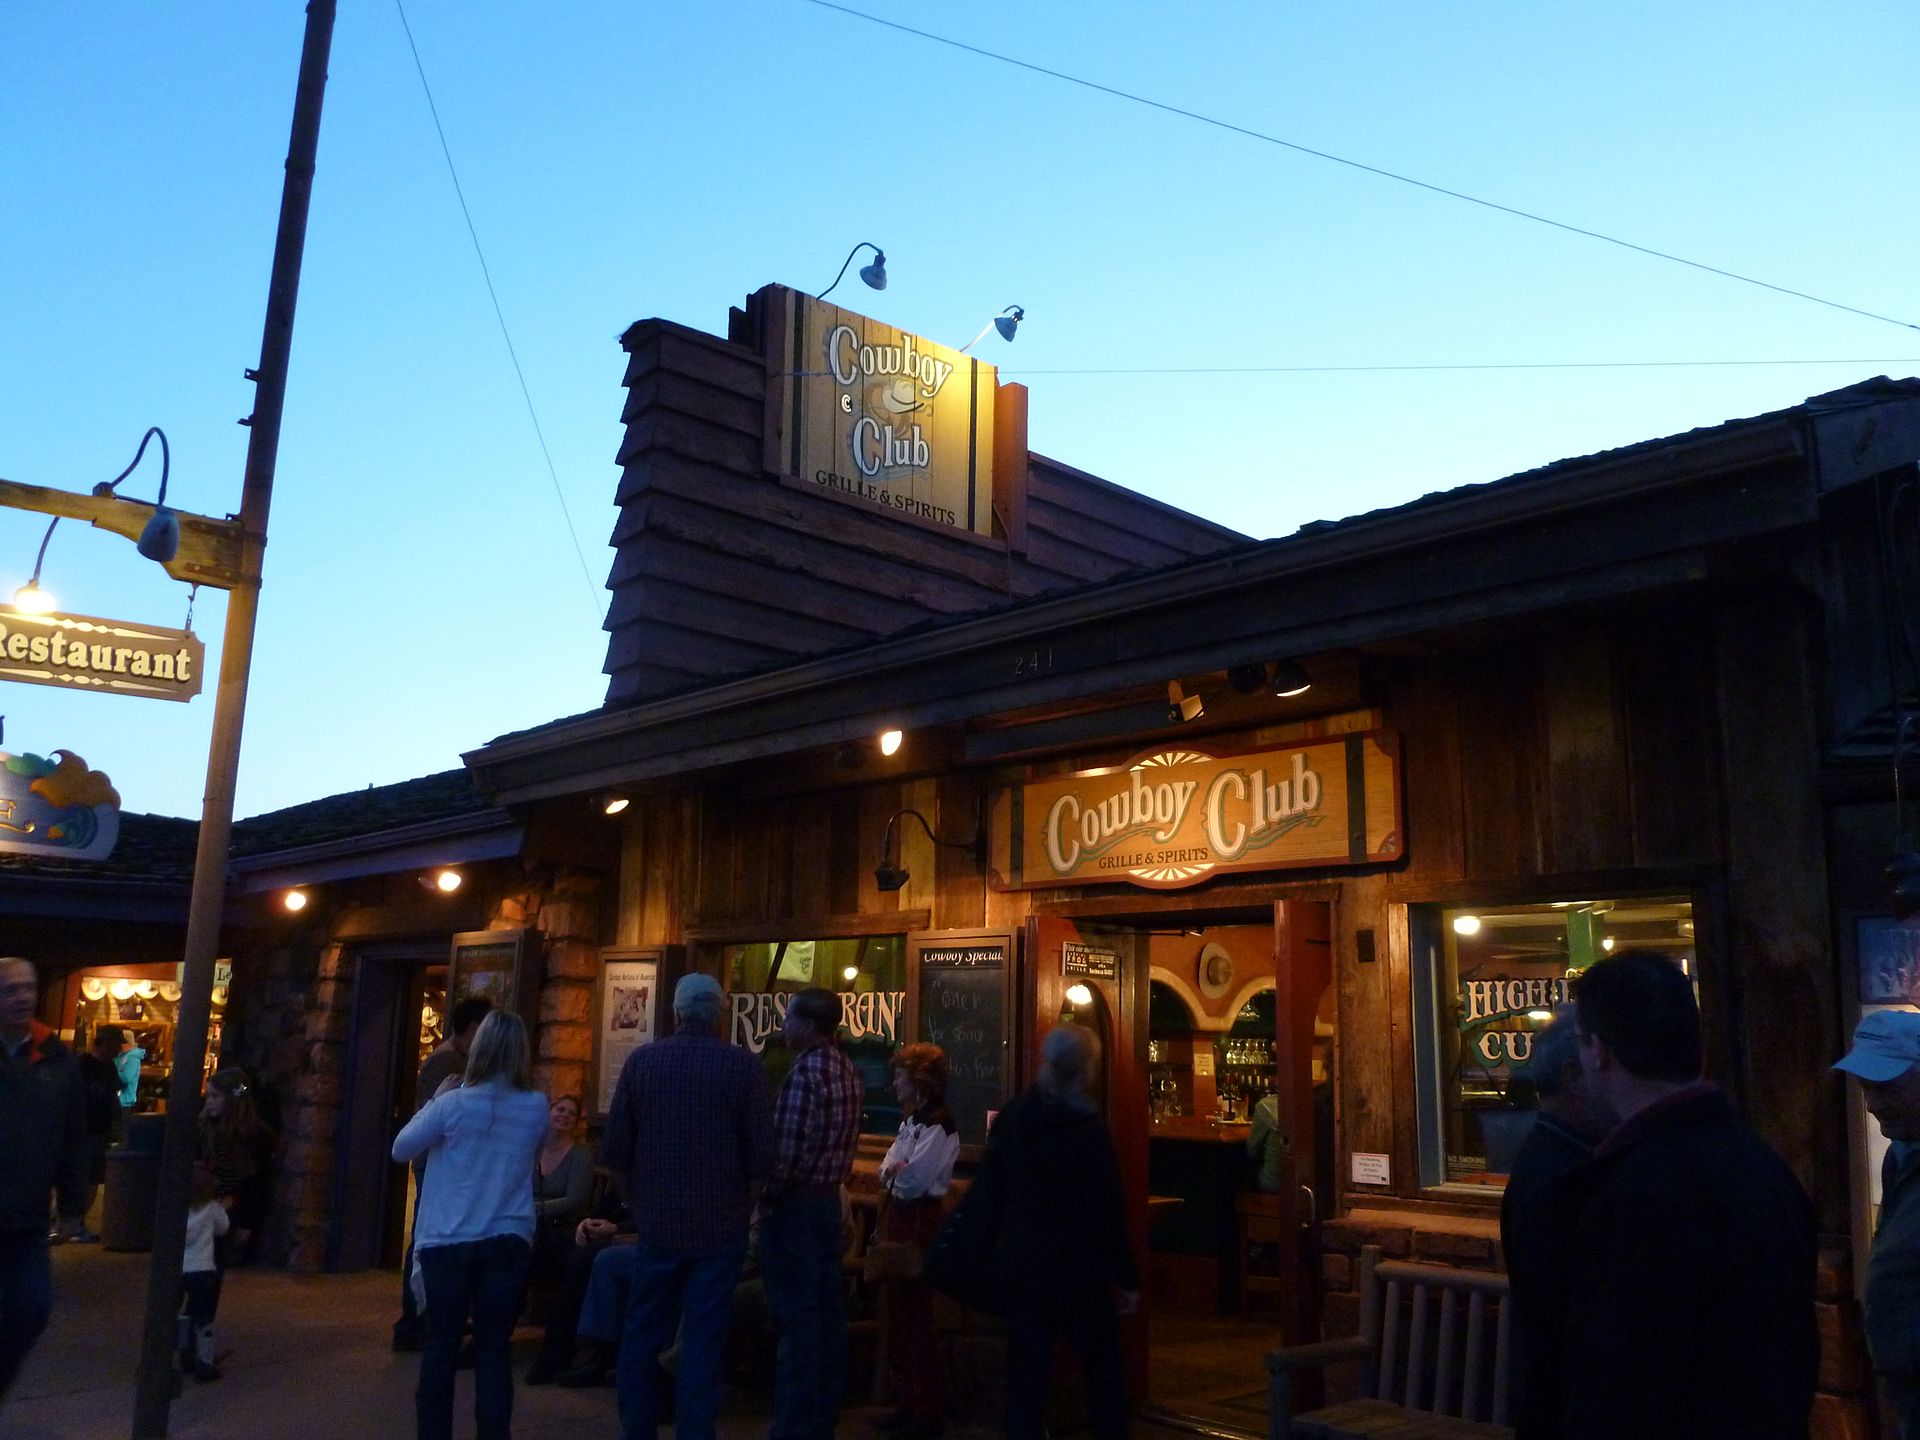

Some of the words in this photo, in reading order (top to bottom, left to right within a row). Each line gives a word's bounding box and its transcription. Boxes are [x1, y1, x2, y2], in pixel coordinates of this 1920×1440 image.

[829, 325, 953, 398] Cowboy
[852, 416, 930, 476] Club
[815, 470, 878, 501] GRILLE
[879, 489, 893, 505] &
[894, 495, 956, 526] SPIRITS
[1048, 769, 1198, 871] Cowboy
[1208, 753, 1320, 856] Club
[1099, 853, 1143, 869] GRILLE
[1145, 852, 1155, 864] &
[1156, 847, 1209, 863] SPIRITS
[1466, 979, 1548, 1022] HIGH
